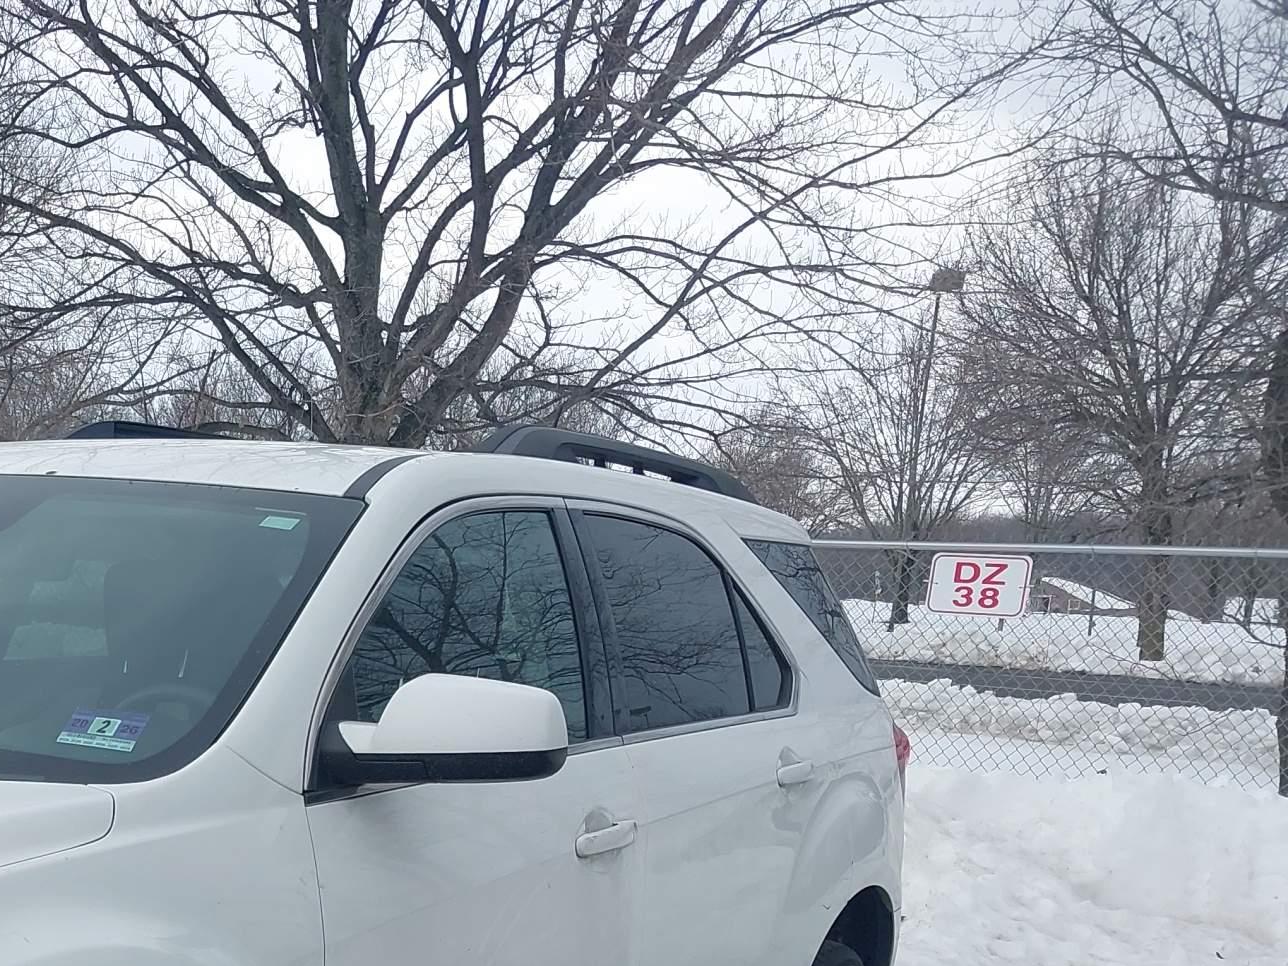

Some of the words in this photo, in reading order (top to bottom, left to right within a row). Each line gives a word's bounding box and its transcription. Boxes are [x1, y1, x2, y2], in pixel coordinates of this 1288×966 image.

[953, 561, 1009, 585] DZ
[952, 586, 1000, 609] 38
[71, 718, 89, 729] 20
[96, 720, 111, 733] 2
